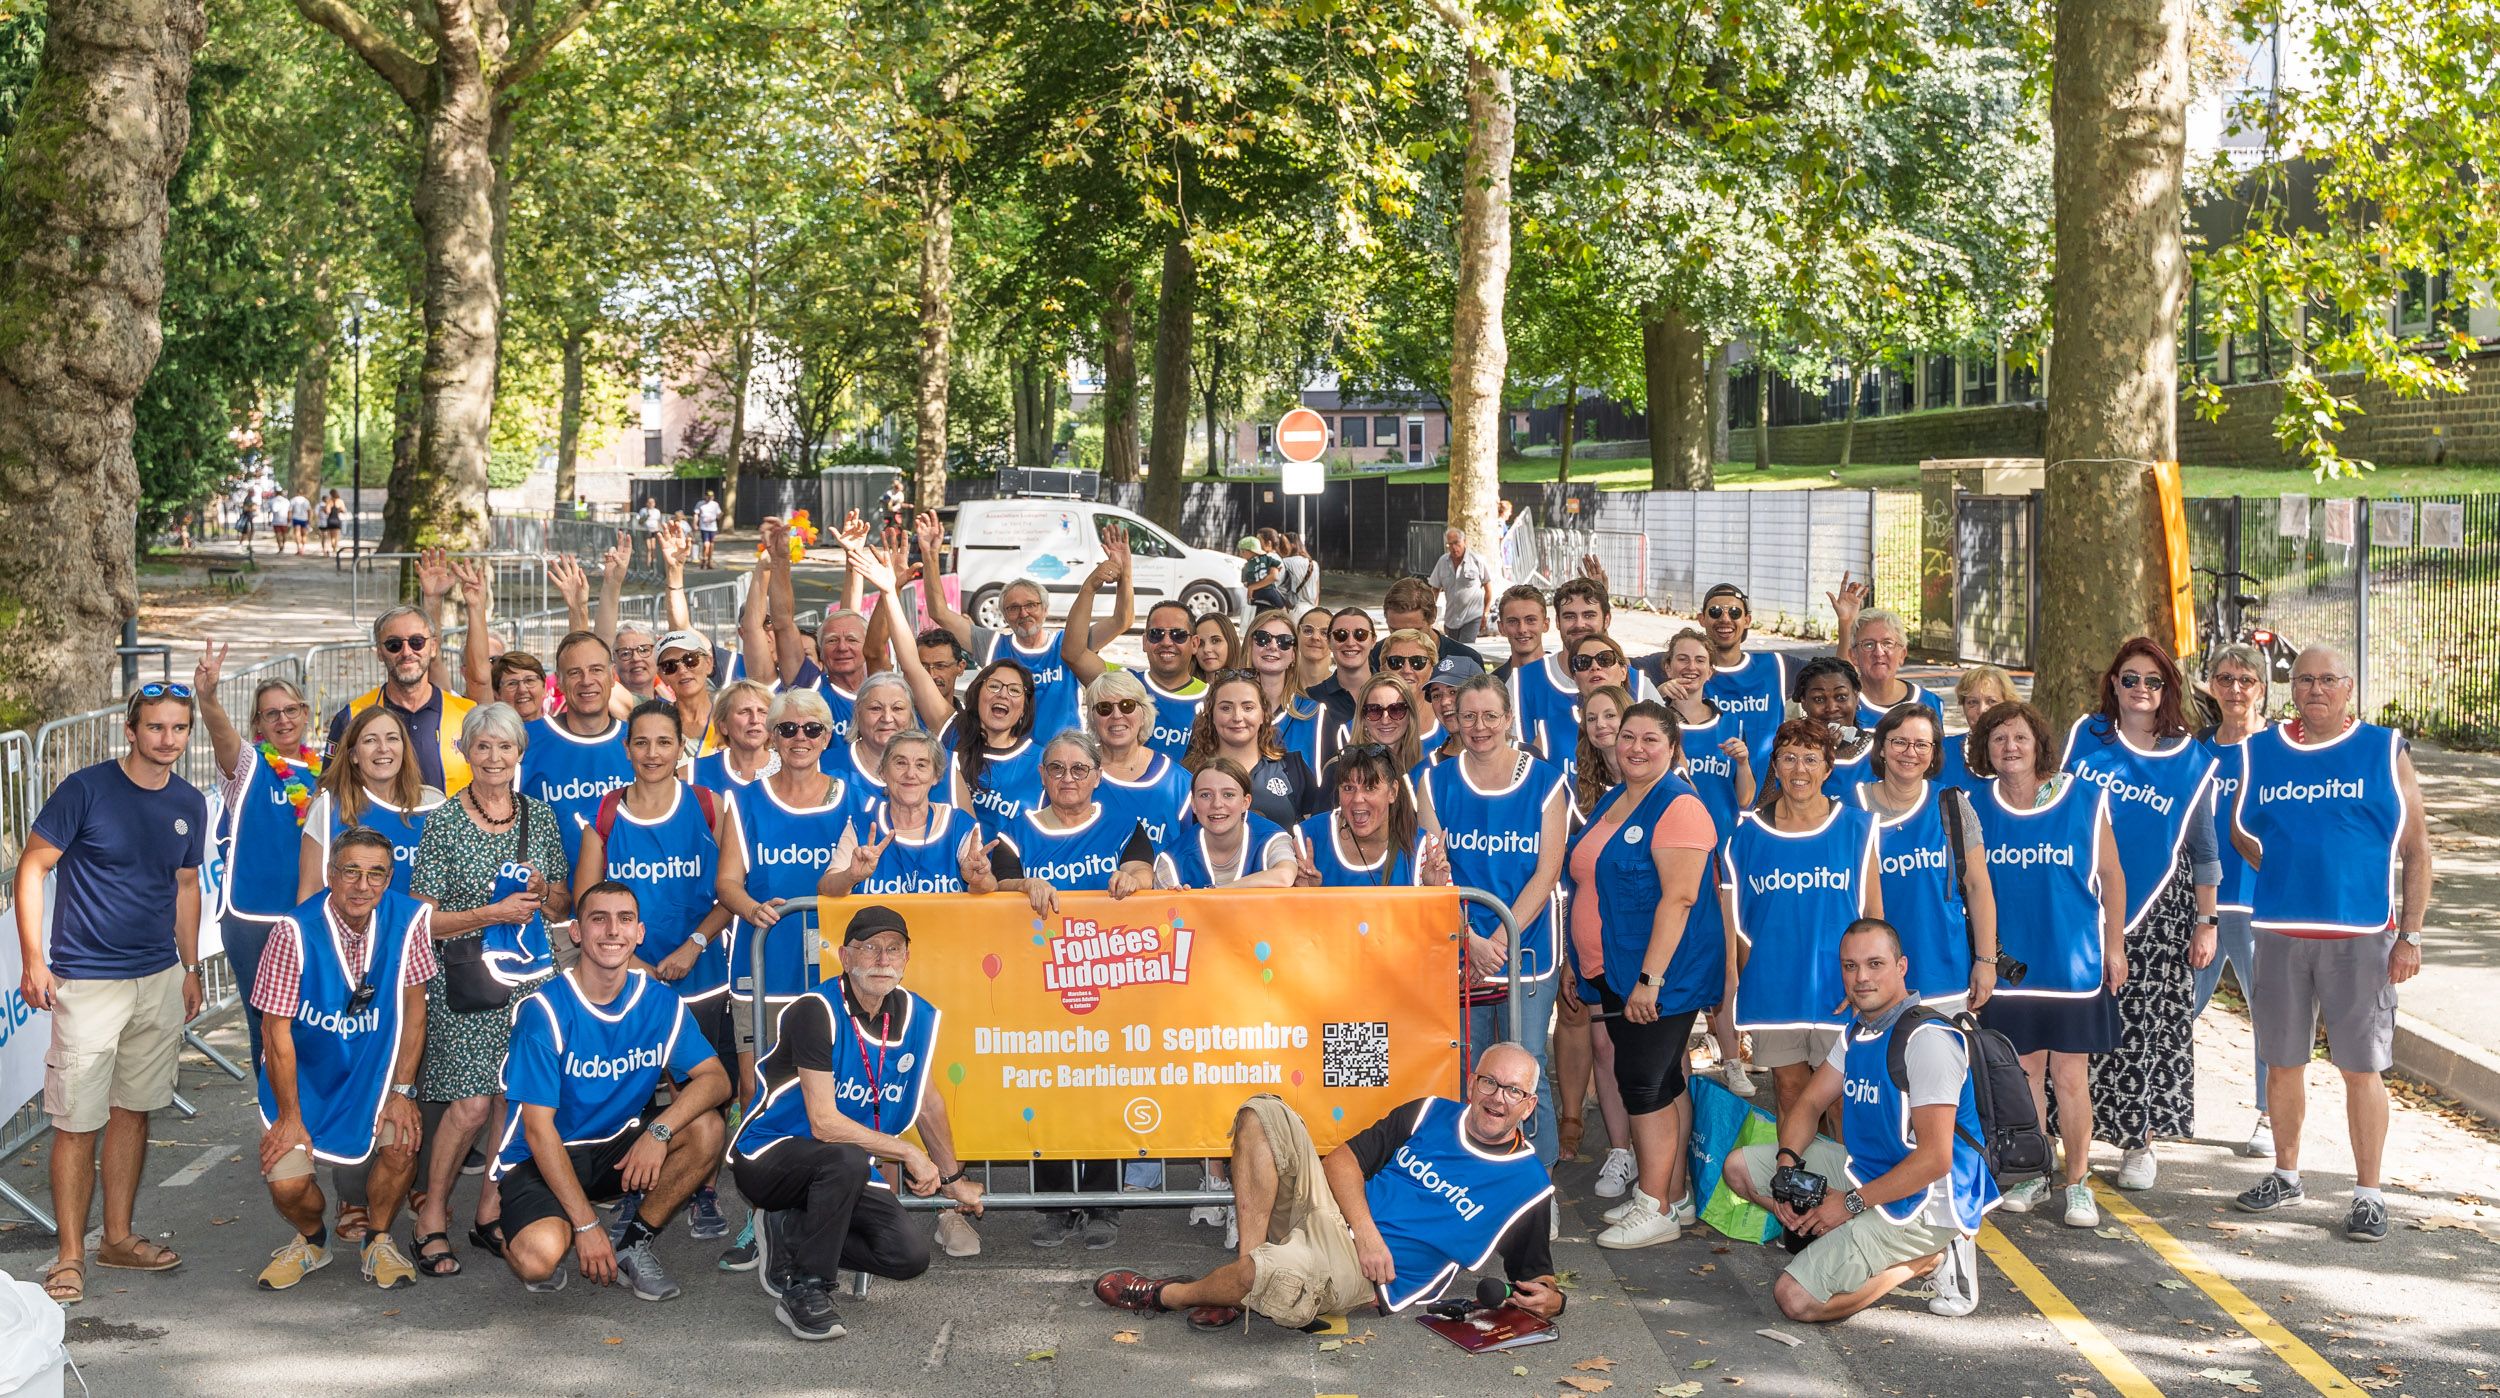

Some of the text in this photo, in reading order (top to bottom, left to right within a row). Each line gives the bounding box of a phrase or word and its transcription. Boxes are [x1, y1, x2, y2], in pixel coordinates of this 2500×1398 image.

[1032, 665, 1063, 685] pital
[1687, 755, 1731, 778] pital
[2076, 760, 2175, 816] ludopital
[2260, 778, 2364, 806] ludopital
[971, 789, 1020, 819] pital
[608, 855, 701, 885] udopital
[757, 842, 837, 870] ludopi
[1880, 845, 1948, 877] opital
[1986, 843, 2073, 870] udopital
[1065, 919, 1097, 938] Les
[1052, 928, 1159, 965] Foulées
[974, 1022, 1309, 1055] Dimanche 10 septembre
[565, 1042, 663, 1081] ludopital
[1002, 1060, 1282, 1088] Parc Barbieux de Roubaix
